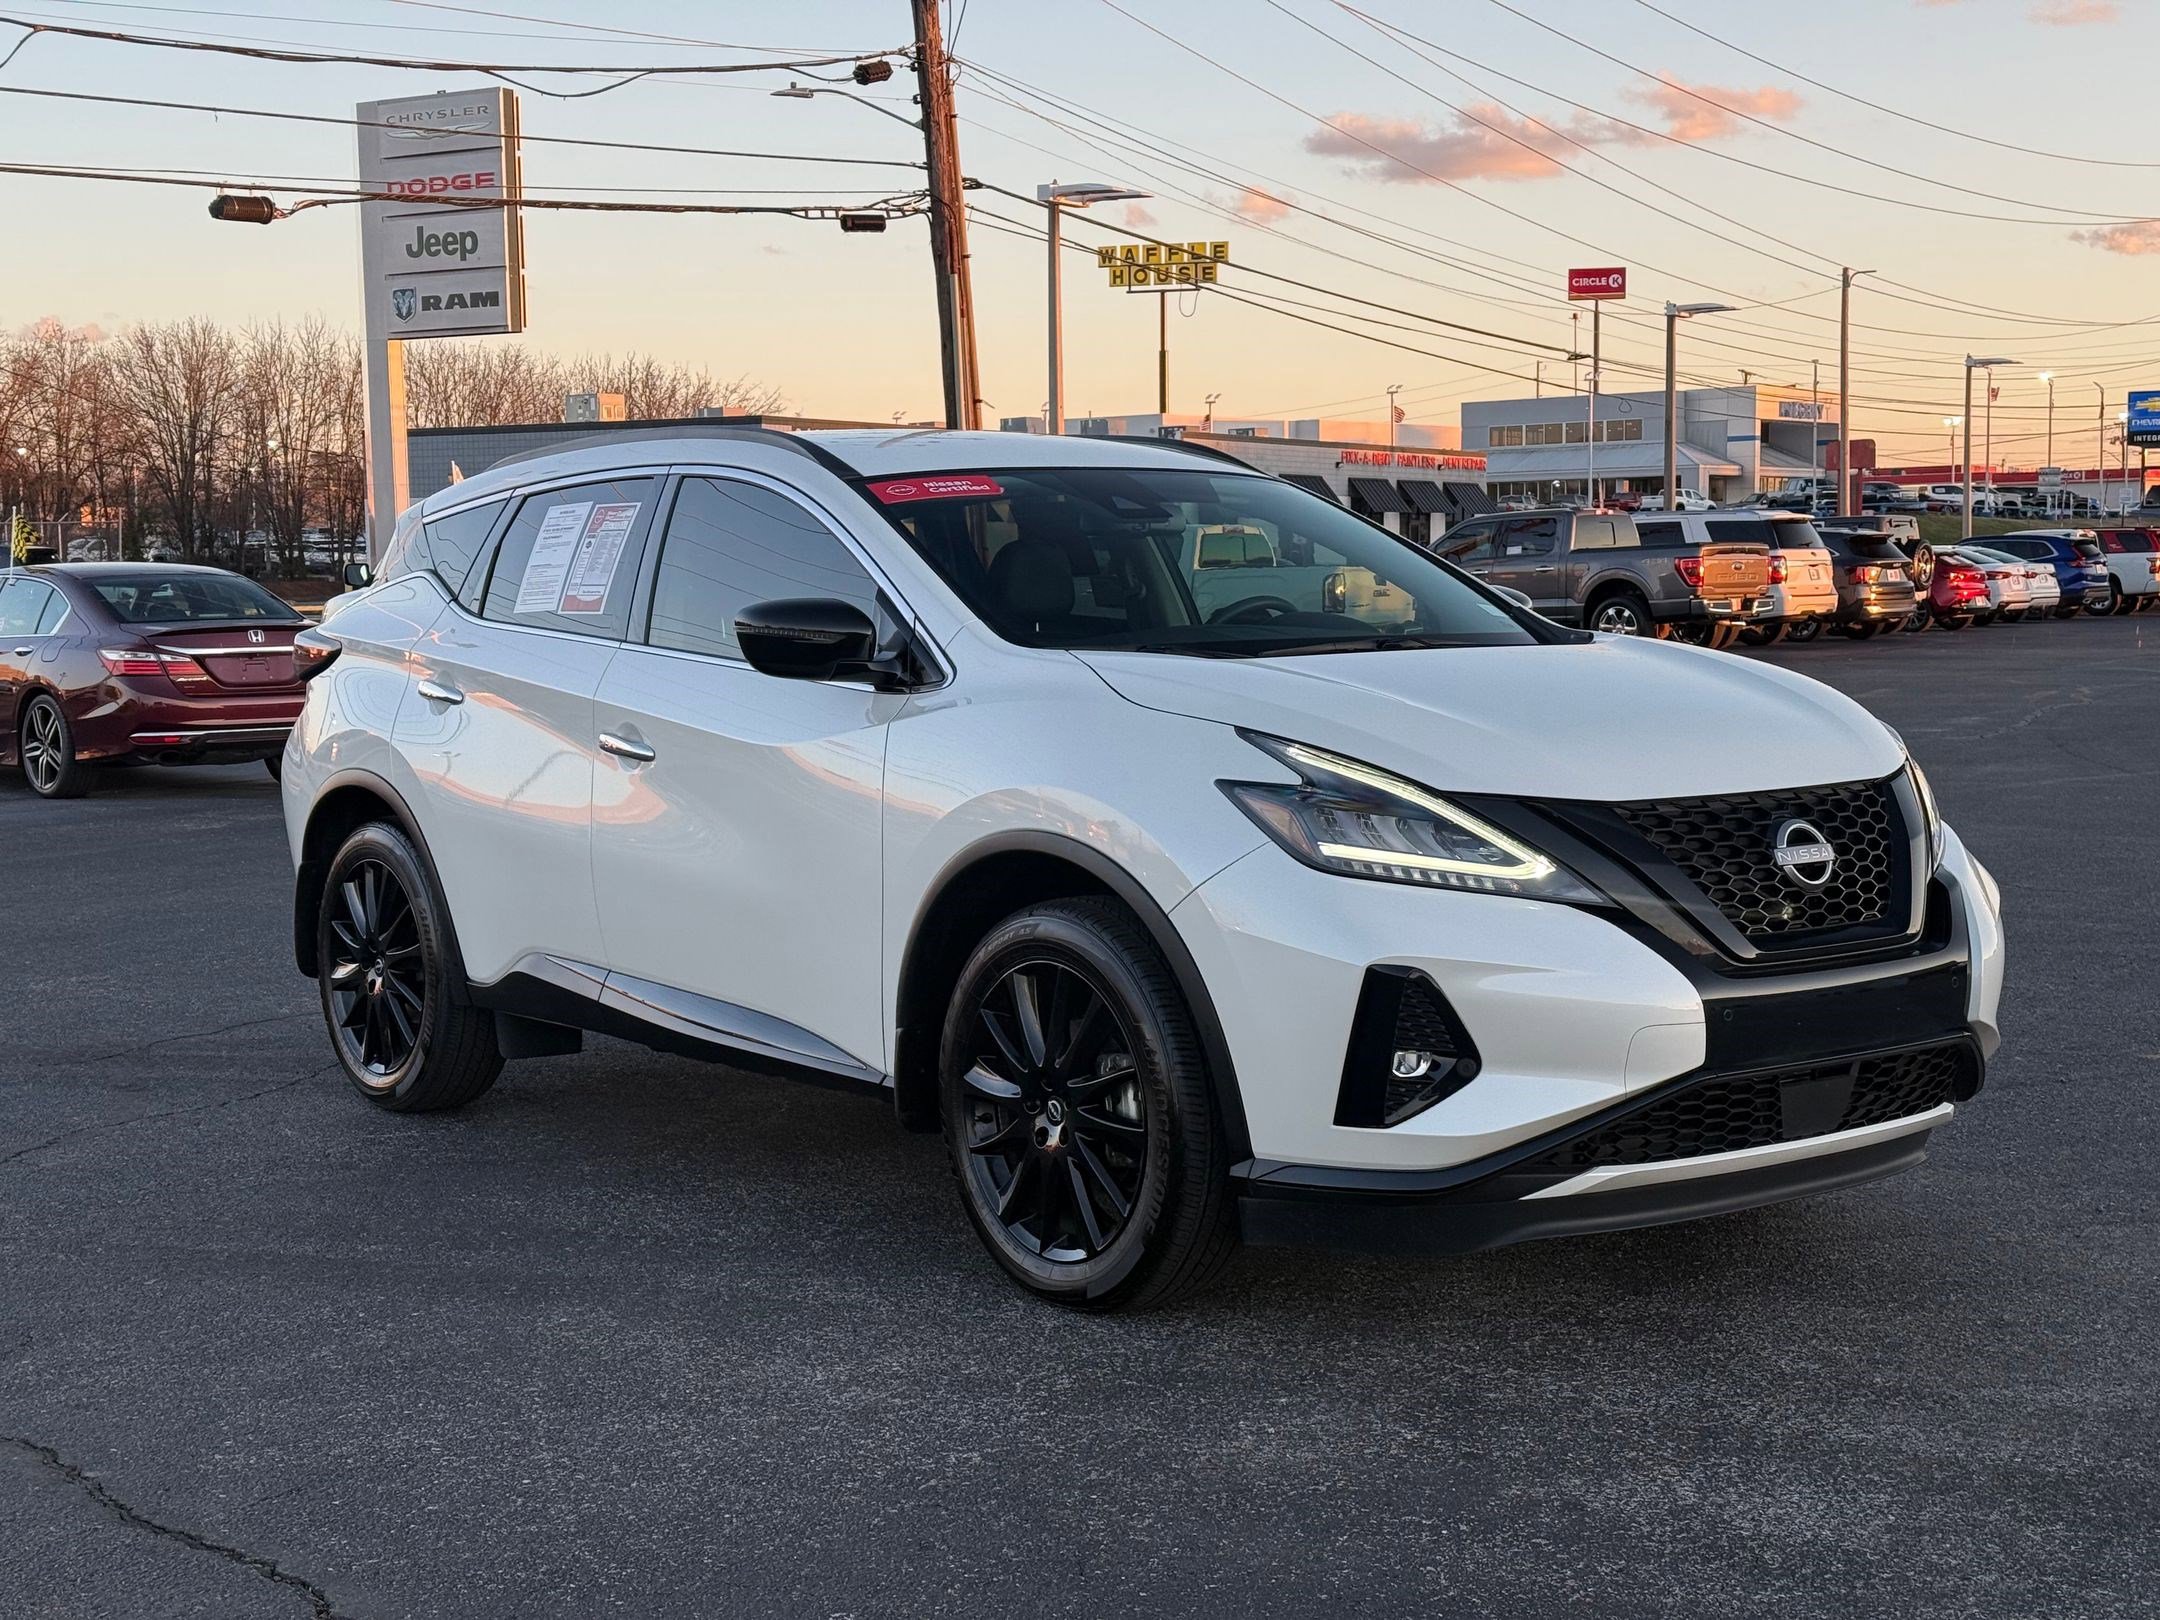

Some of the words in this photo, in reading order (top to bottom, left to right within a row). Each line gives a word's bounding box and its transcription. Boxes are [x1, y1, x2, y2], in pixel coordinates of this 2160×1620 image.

[386, 105, 489, 124] CHRYSLER
[387, 172, 496, 196] DODGE
[405, 226, 478, 261] Jeep
[1100, 244, 1225, 264] WAFFLE
[1112, 265, 1214, 285] HOUSE
[1572, 277, 1608, 287] CIRCLE
[421, 291, 500, 312] RAM
[923, 480, 972, 489] Nissan
[928, 484, 991, 494] Certified
